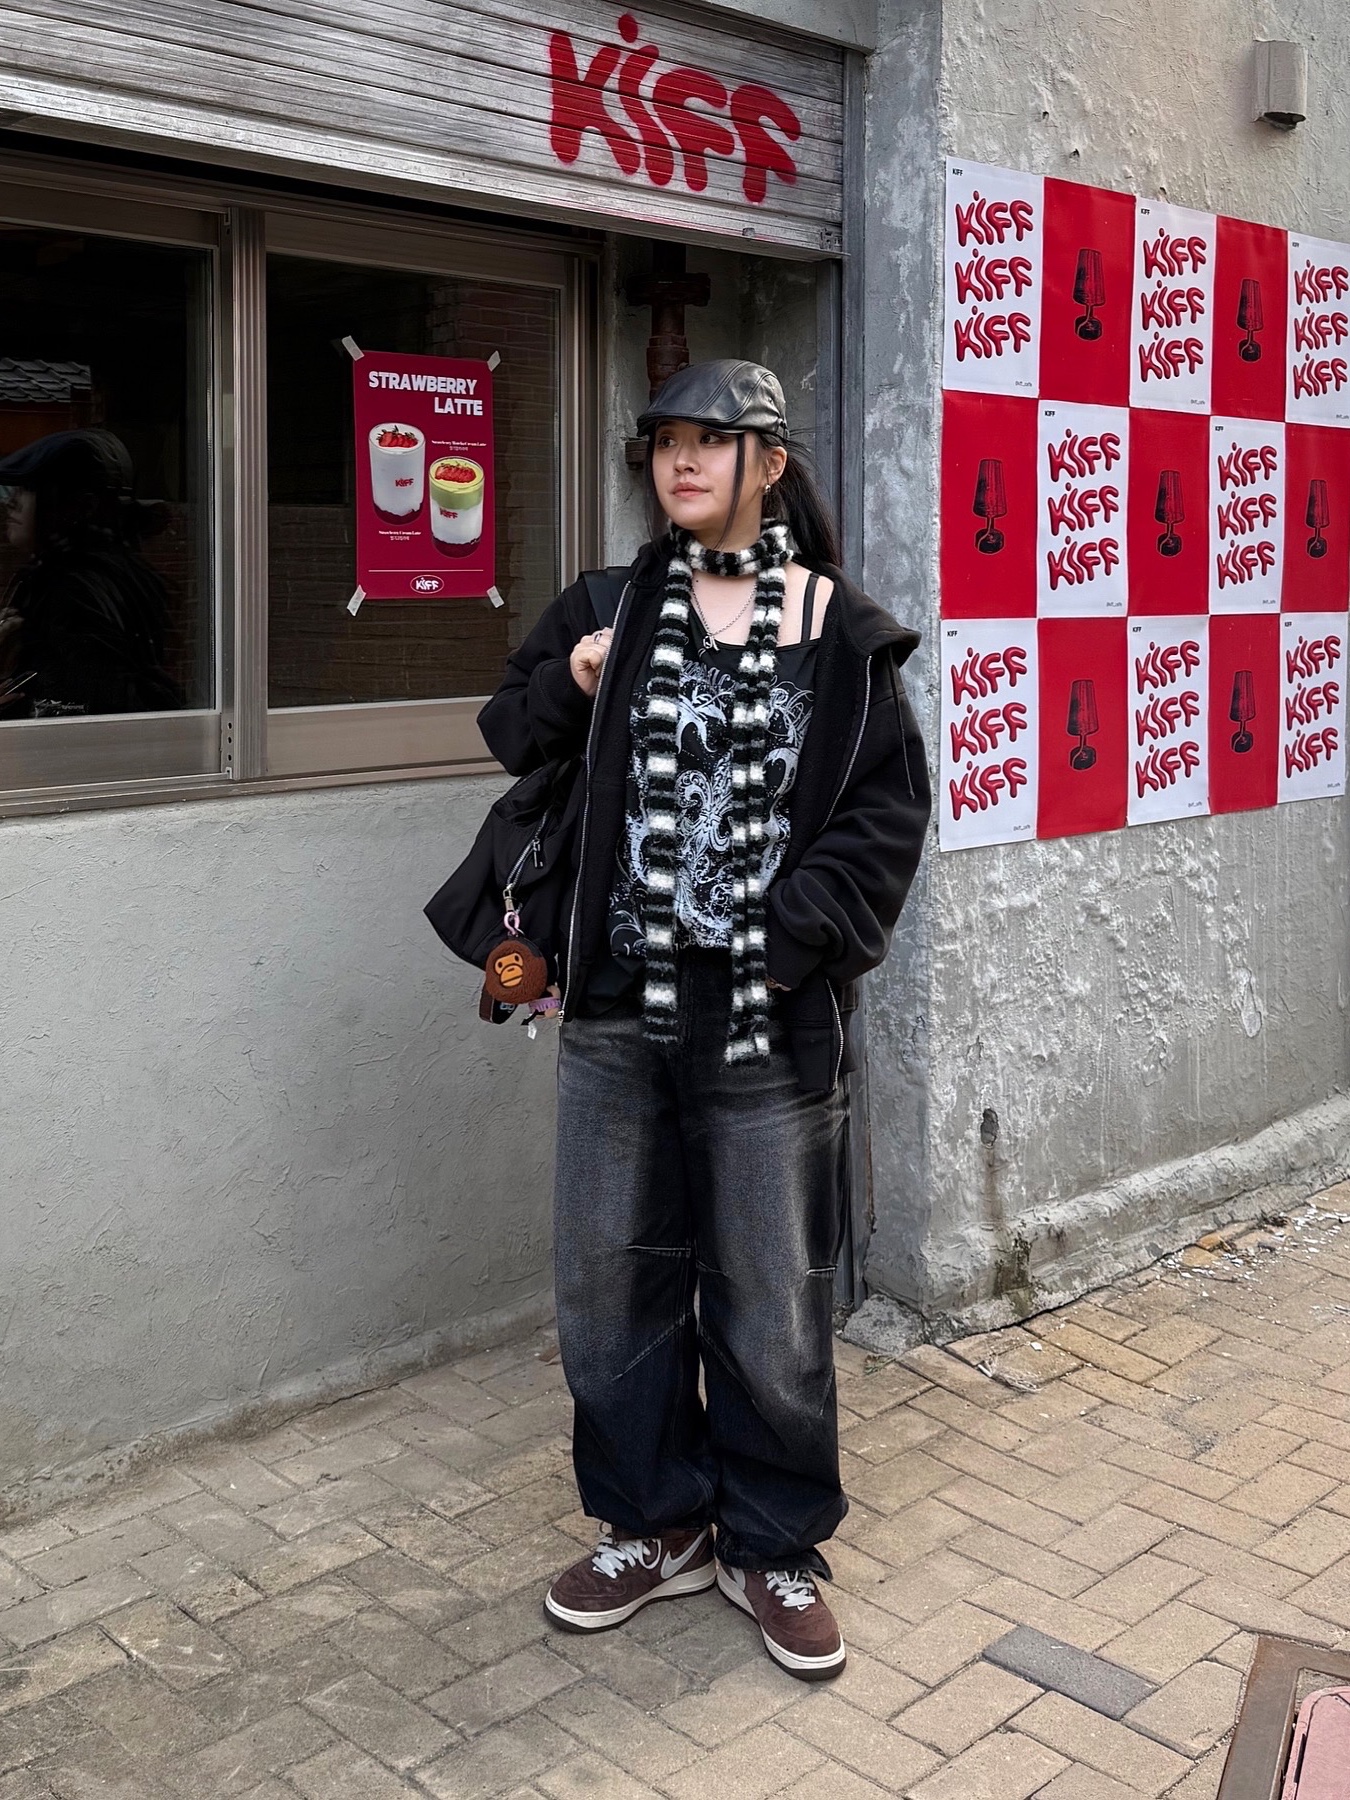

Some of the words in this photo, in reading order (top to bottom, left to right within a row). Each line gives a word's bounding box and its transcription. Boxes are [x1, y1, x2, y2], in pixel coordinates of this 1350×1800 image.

[952, 168, 963, 177] KIFF
[368, 370, 478, 395] STRAWBERRY
[434, 397, 484, 416] LATTE
